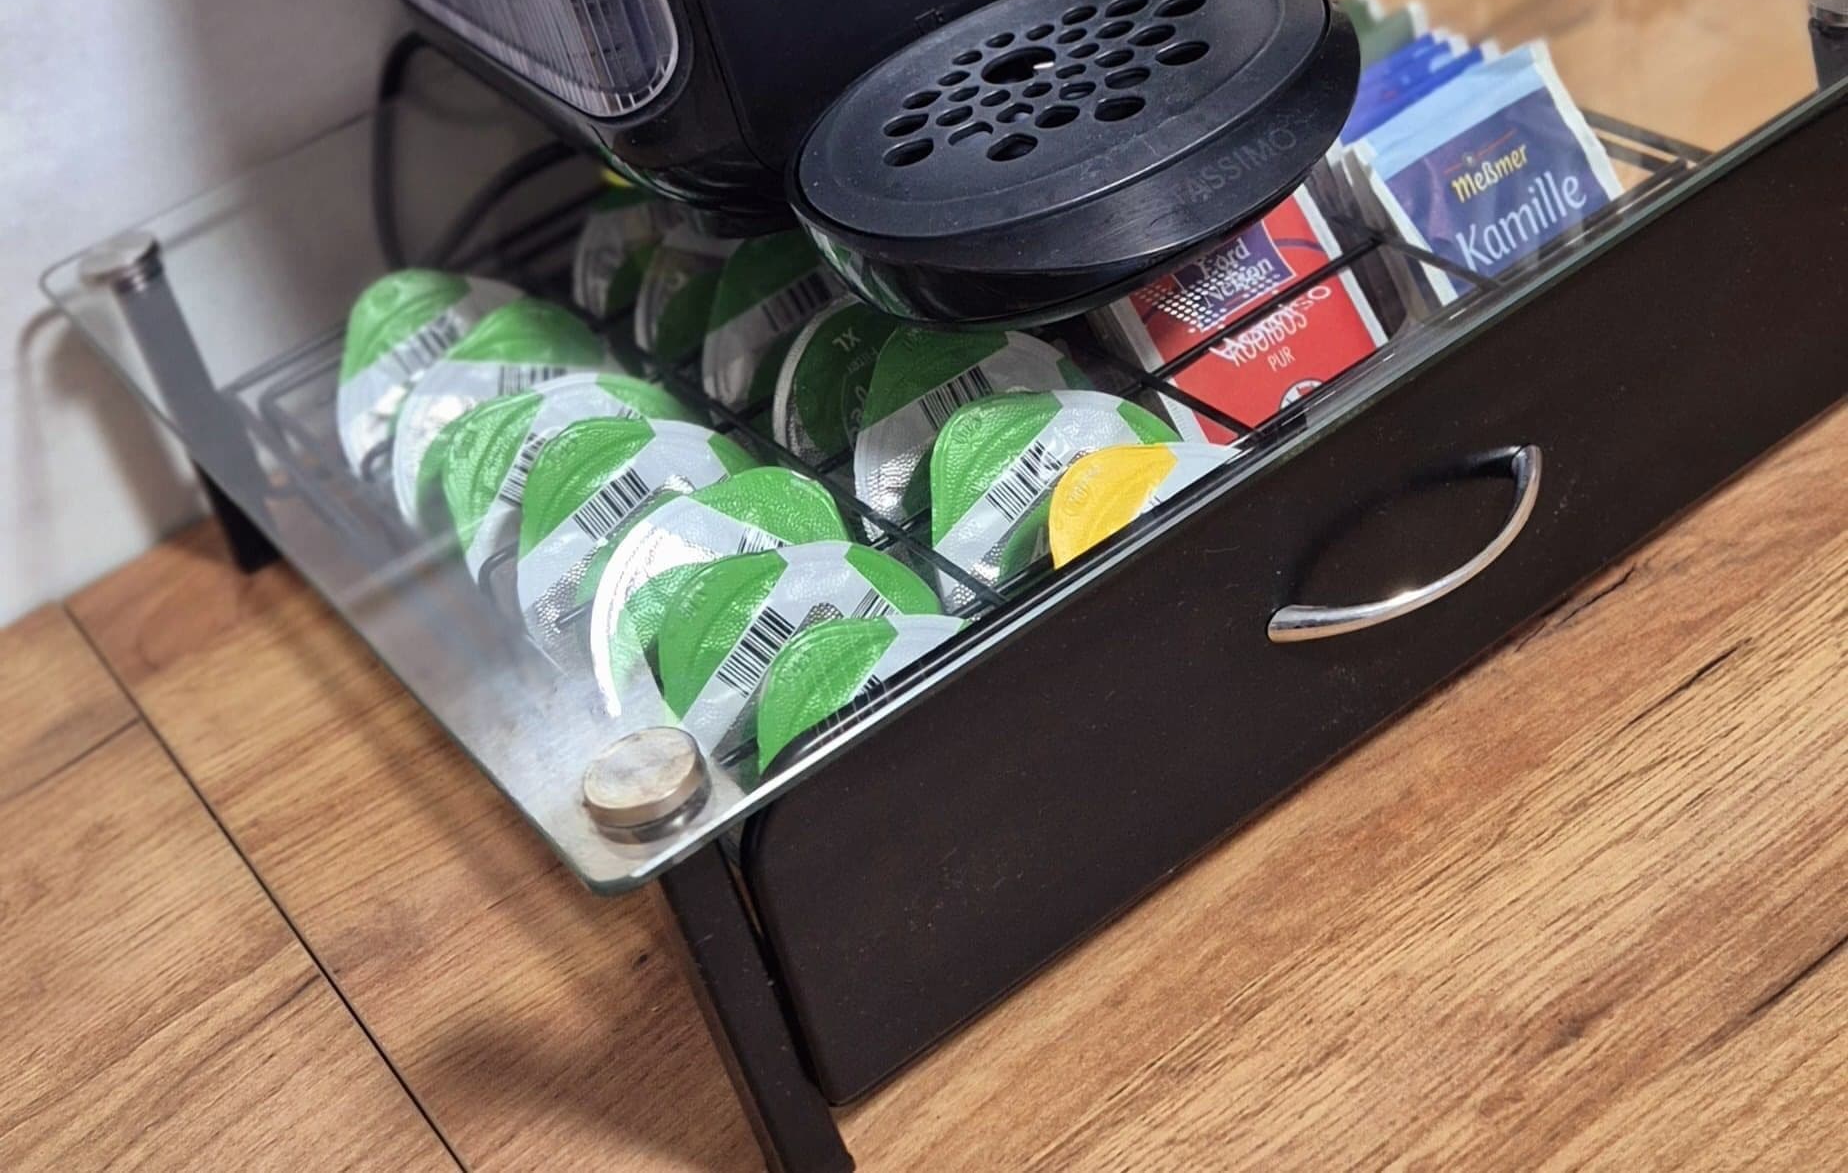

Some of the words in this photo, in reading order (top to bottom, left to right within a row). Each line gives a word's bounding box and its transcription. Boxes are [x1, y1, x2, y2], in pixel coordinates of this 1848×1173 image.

[1451, 144, 1528, 203] Meßmer
[1455, 171, 1587, 273] Kamille
[832, 326, 861, 352] XL
[1267, 346, 1296, 372] PUR
